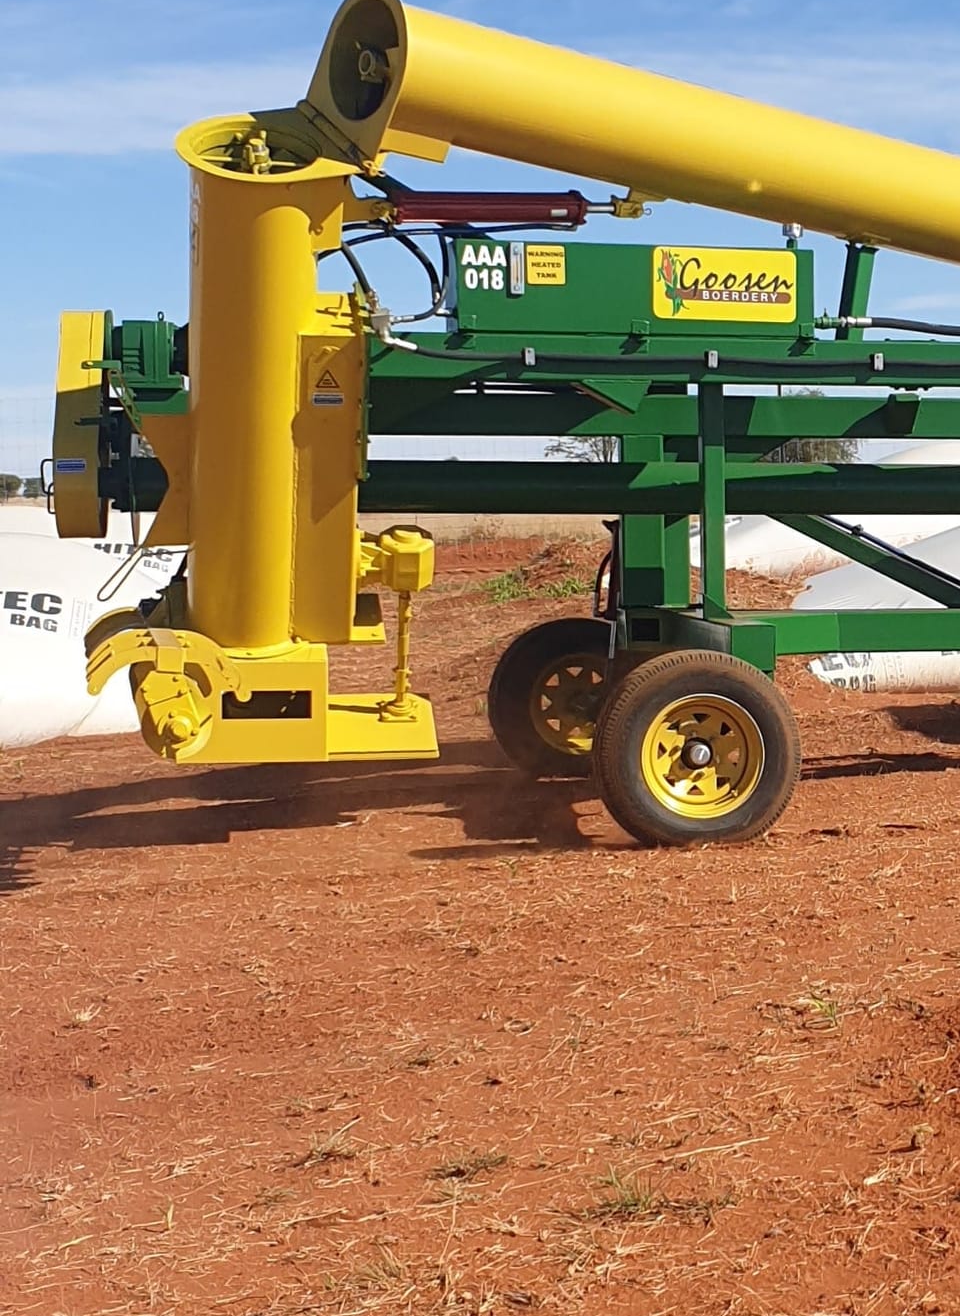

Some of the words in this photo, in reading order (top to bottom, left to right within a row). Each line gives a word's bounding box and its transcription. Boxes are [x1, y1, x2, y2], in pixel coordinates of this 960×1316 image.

[461, 244, 507, 267] AAA
[465, 268, 504, 290] 018
[679, 257, 793, 298] Goosen
[702, 291, 778, 302] BOERDERY
[0, 590, 63, 615] EC
[10, 613, 59, 633] BAG
